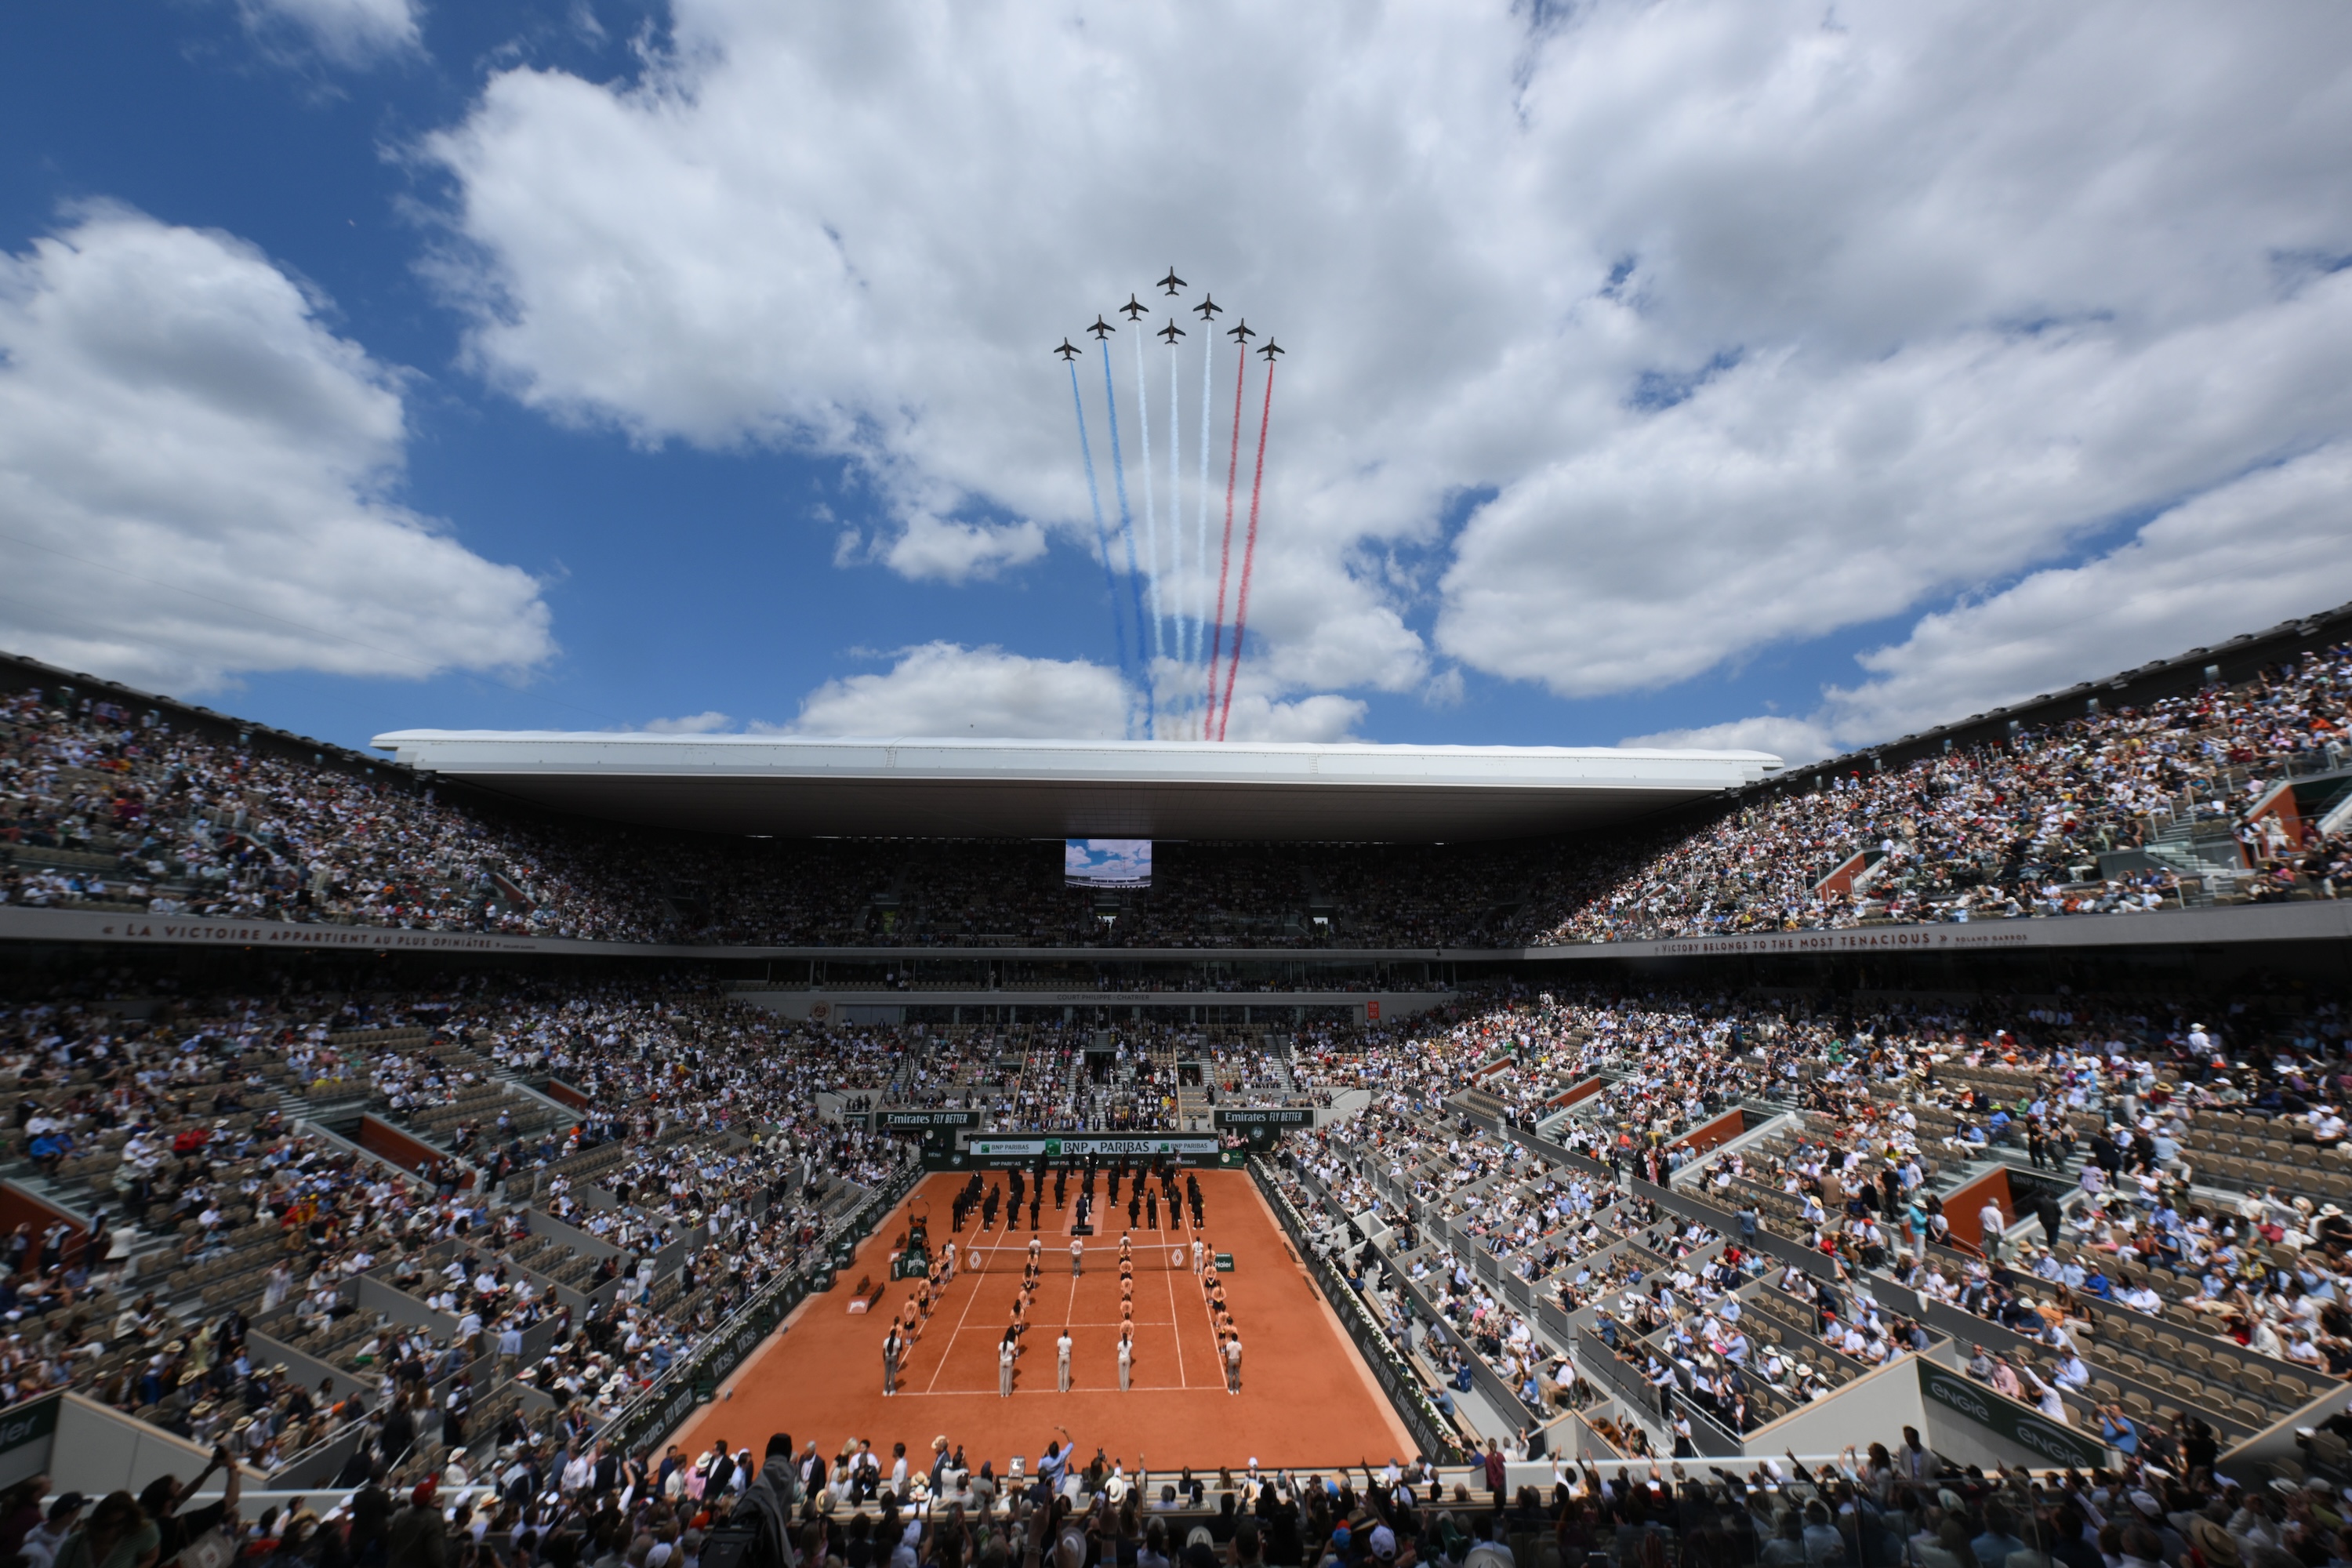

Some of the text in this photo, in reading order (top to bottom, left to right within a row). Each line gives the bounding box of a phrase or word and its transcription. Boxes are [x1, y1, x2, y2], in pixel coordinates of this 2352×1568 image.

[126, 924, 152, 936] LA
[165, 926, 261, 940] VICTOIRE
[269, 931, 368, 944] APPARTIENT
[374, 935, 390, 946] AU
[397, 936, 426, 946] PLUS
[1662, 943, 1700, 953] VICTORY
[1704, 942, 1748, 951] BELONGS
[1753, 940, 1766, 949] TO
[1771, 939, 1794, 948] THE
[1800, 938, 1834, 947] MOST
[1841, 933, 1930, 946] TENACIOUS
[887, 1113, 968, 1124] Emirates FLY BETTER
[1225, 1112, 1302, 1122] Emirates FLY BETTER
[1064, 1142, 1149, 1152] BNP PARIBAS
[1396, 1387, 1418, 1429] Emirates
[1421, 1430, 1439, 1460] BETTER
